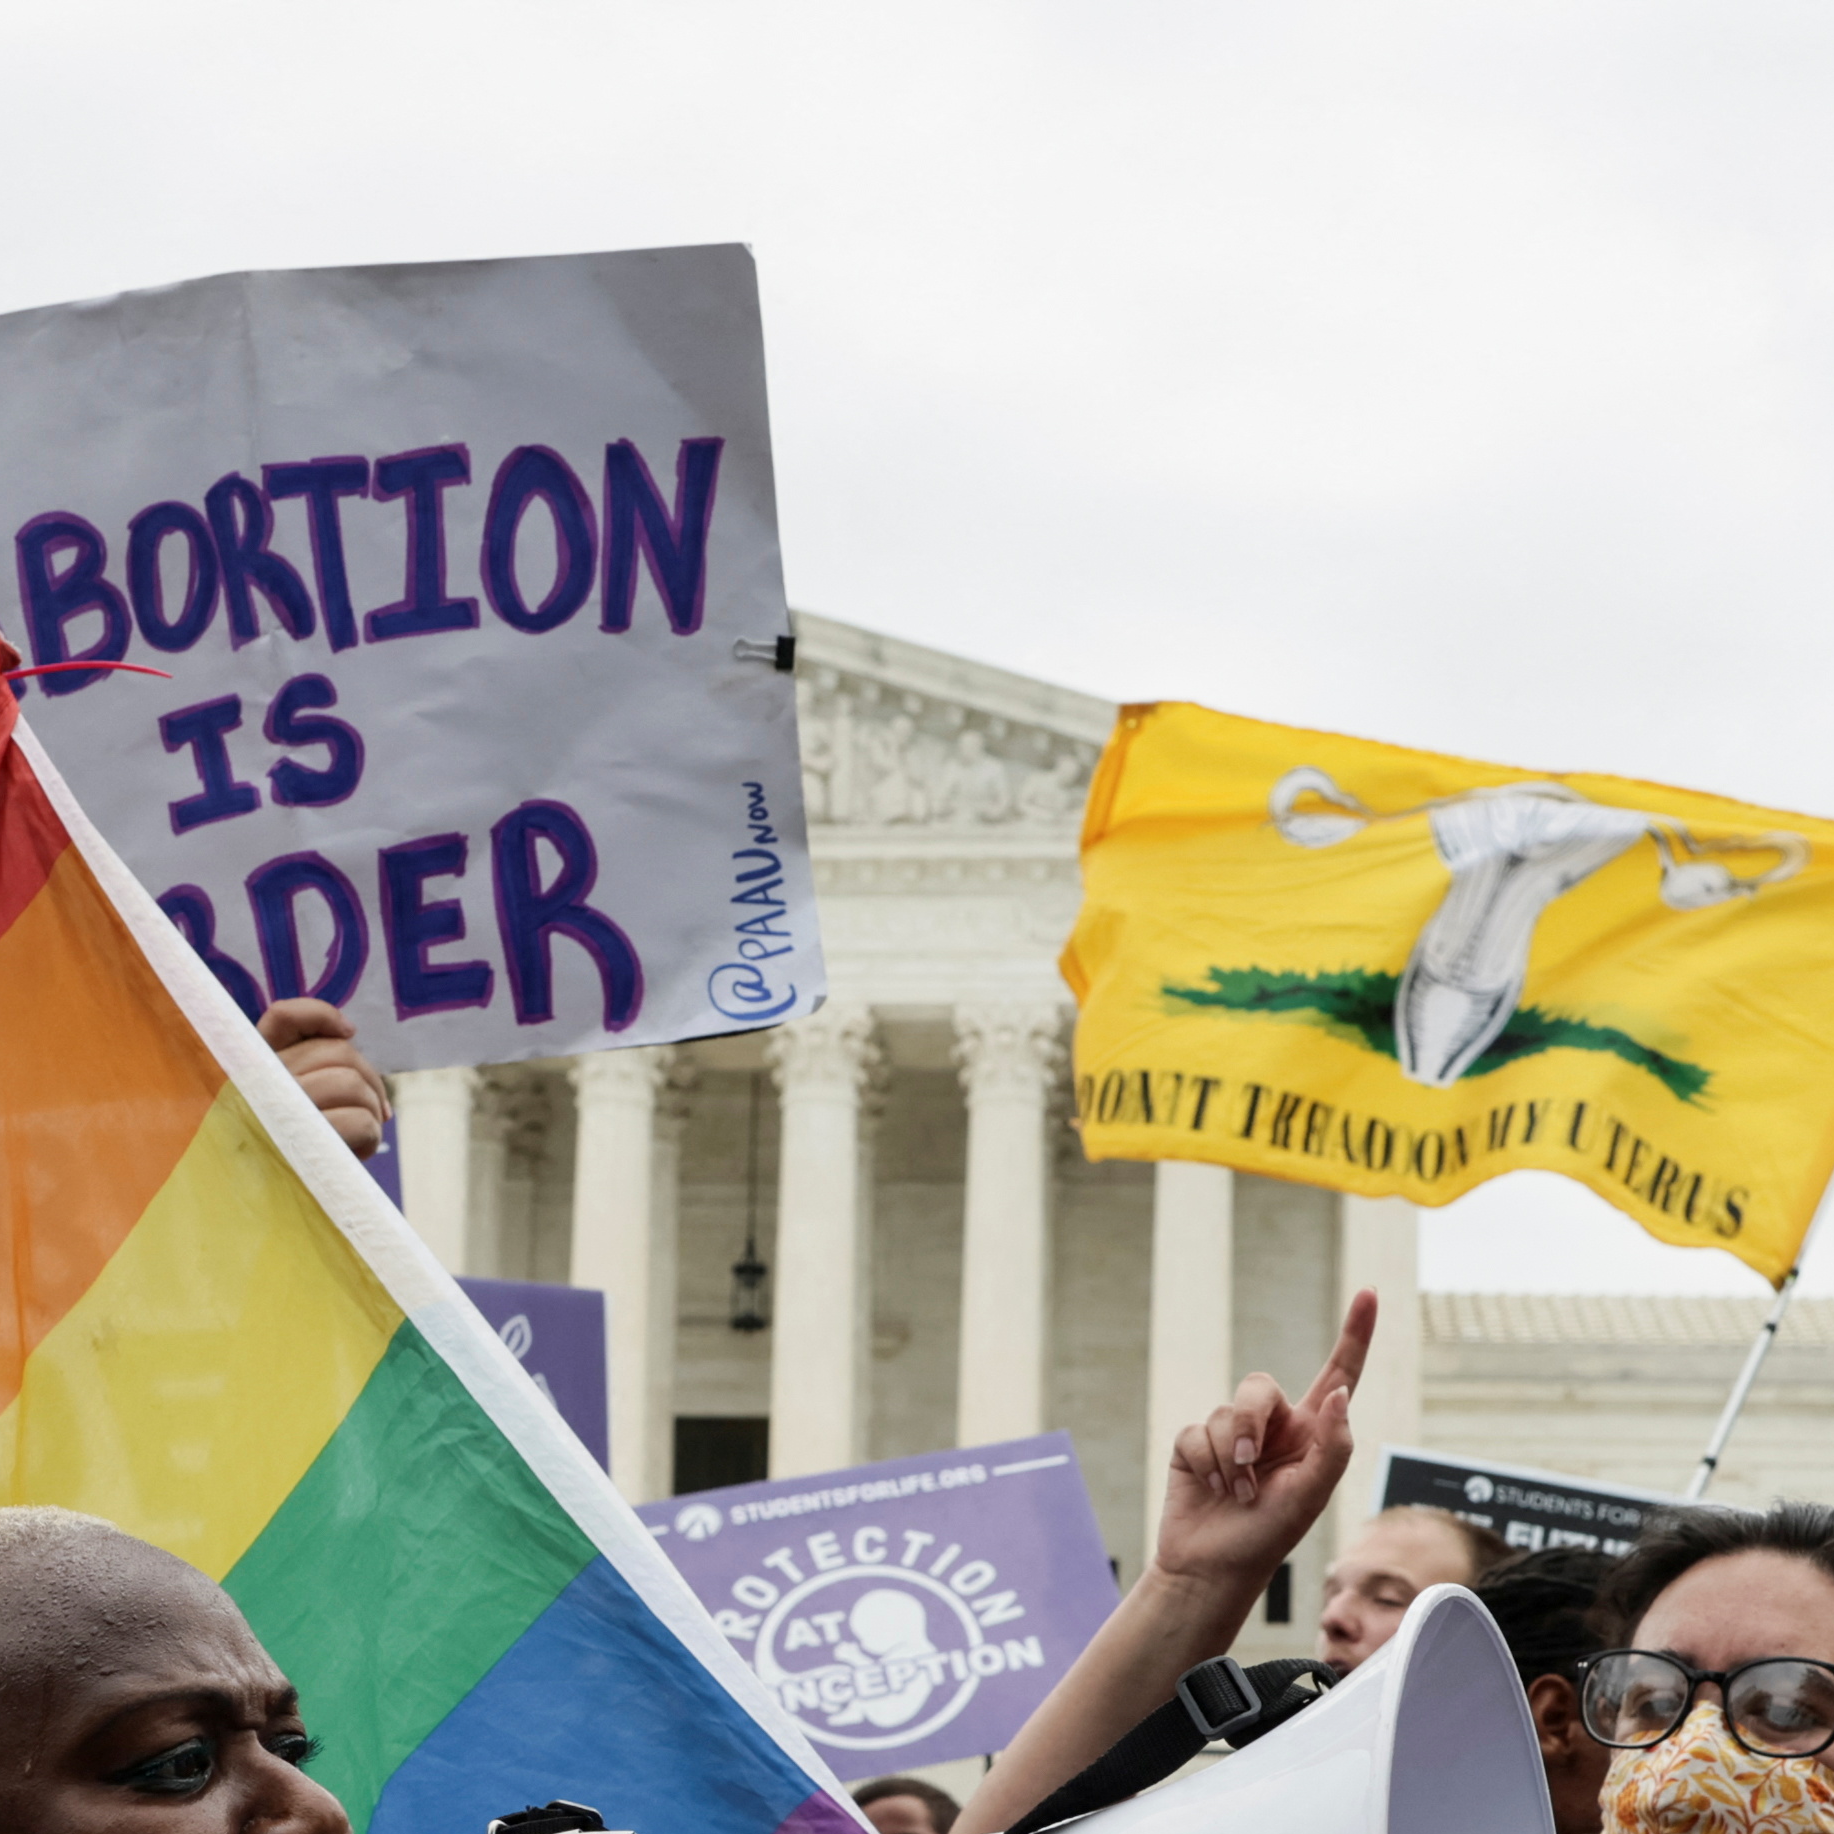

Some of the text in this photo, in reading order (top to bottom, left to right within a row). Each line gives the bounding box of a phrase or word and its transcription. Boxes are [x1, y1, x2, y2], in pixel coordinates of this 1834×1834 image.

[161, 672, 365, 836] IS
[152, 799, 645, 1033] RDER
[1483, 1100, 1543, 1152] MY
[1567, 1100, 1751, 1242] UTERUS
[729, 1464, 987, 1526] STUDENTSFORLIFE.ORG
[1495, 1483, 1594, 1521] STUDENTS
[712, 1525, 1026, 1643] ROTECTION
[782, 1610, 847, 1652] AT
[765, 1635, 1045, 1718] NCEPTION
